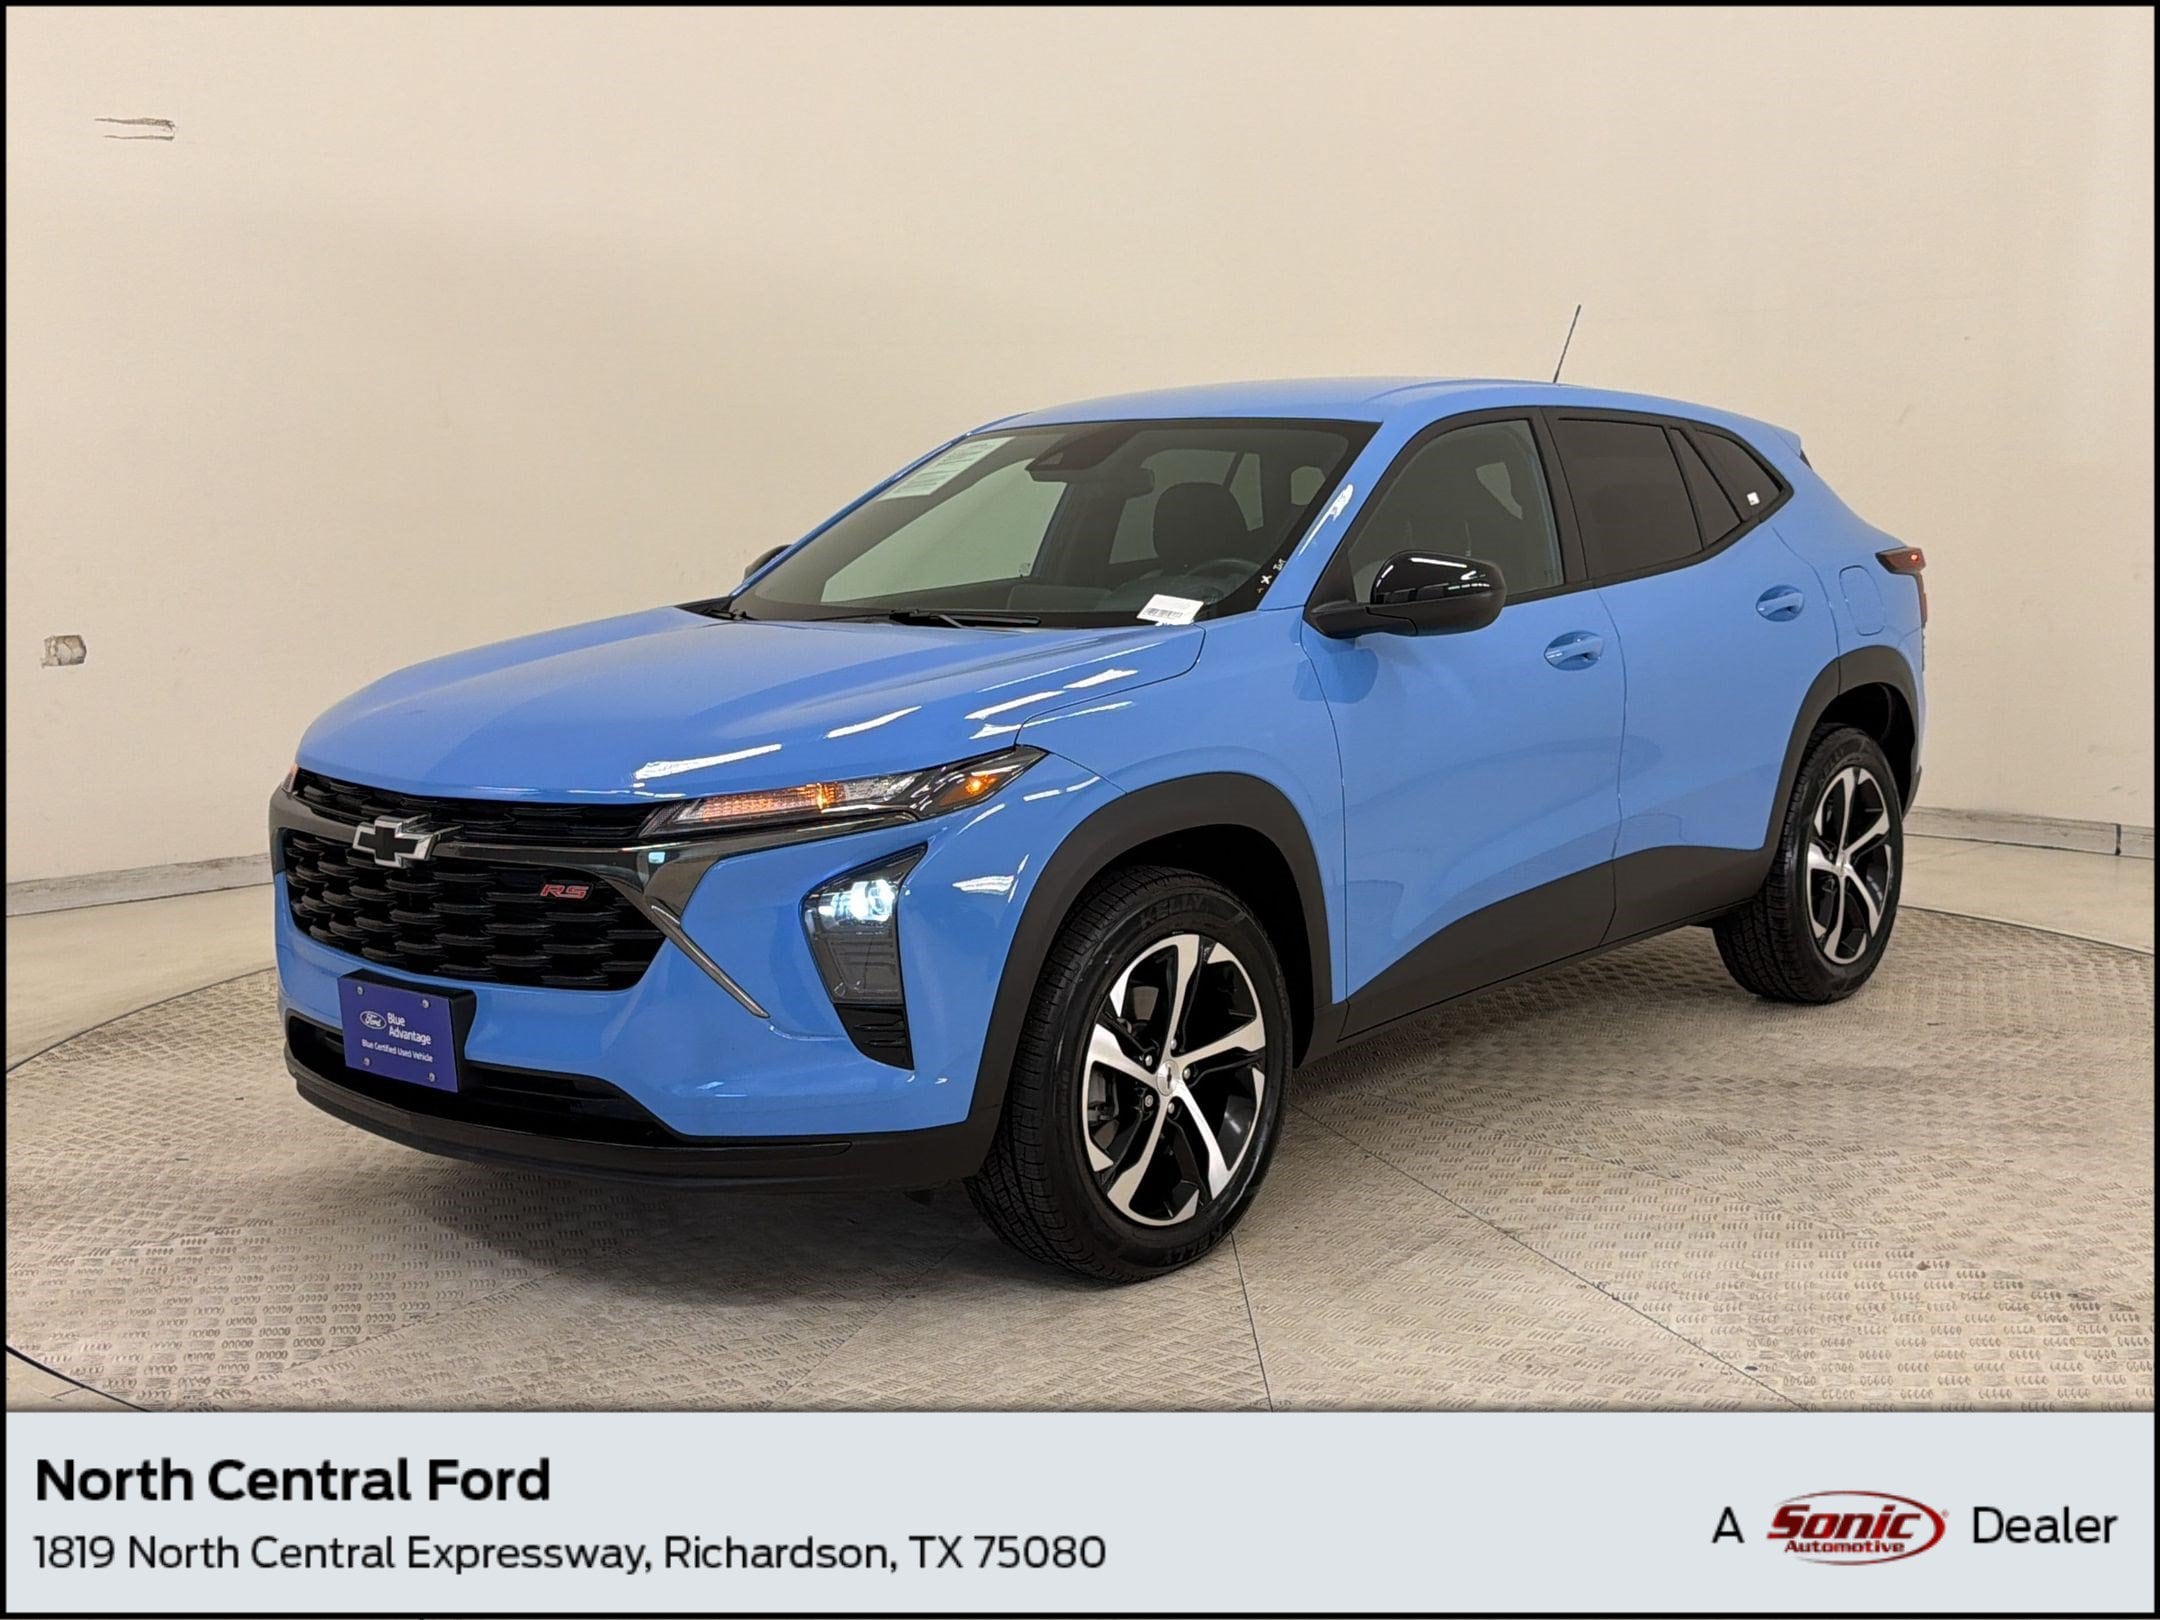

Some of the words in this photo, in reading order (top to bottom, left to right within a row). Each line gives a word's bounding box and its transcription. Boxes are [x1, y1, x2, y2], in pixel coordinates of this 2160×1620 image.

[540, 884, 589, 899] RS
[1137, 894, 1205, 930] KELLY
[364, 1012, 382, 1027] Ford
[387, 1012, 406, 1027] Blue
[388, 1026, 432, 1045] Advantage
[361, 1039, 374, 1049] Blue
[374, 1043, 397, 1055] Certified
[397, 1048, 412, 1058] Used
[412, 1051, 433, 1062] Vehicle
